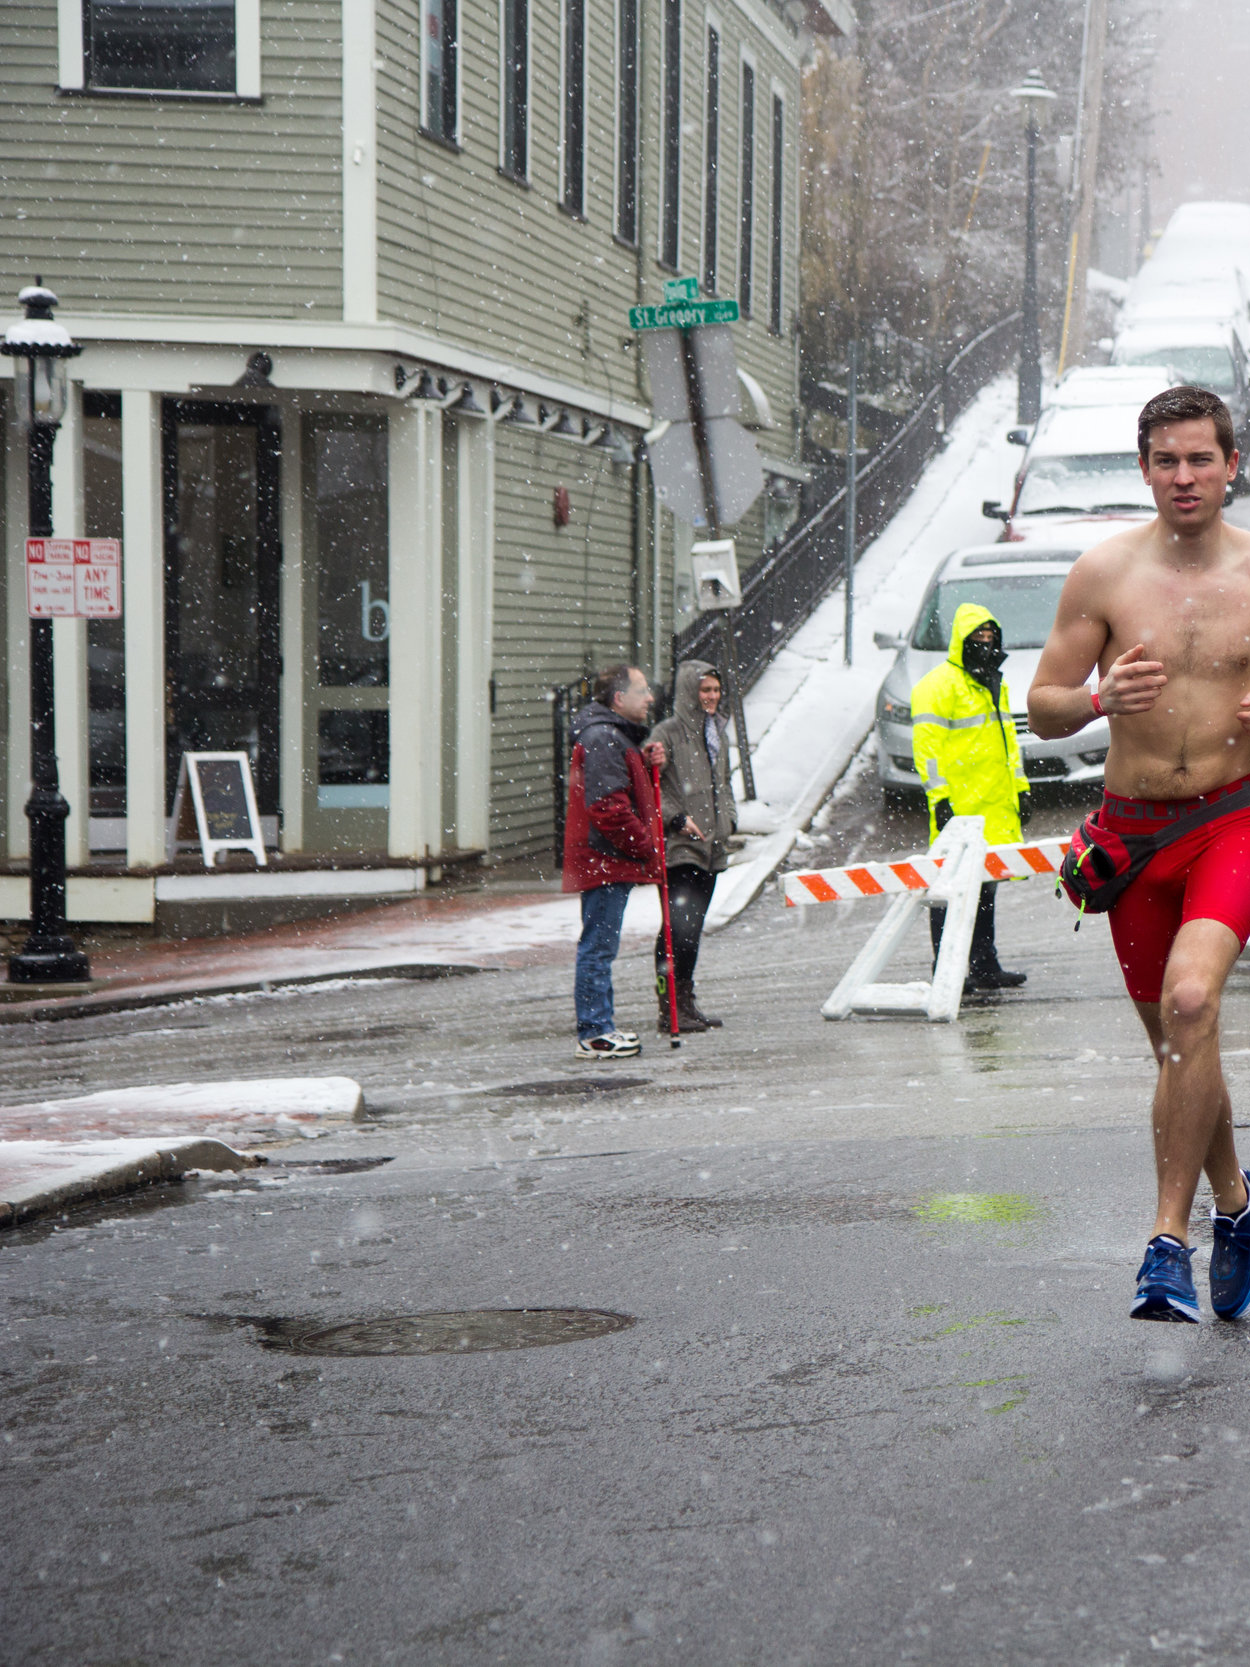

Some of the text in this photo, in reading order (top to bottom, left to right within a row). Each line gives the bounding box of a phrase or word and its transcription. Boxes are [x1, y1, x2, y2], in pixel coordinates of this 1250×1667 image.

[655, 306, 705, 327] Gregory
[29, 543, 43, 560] NO
[75, 543, 89, 560] NO
[84, 568, 108, 582] ANY
[84, 585, 110, 601] TIME
